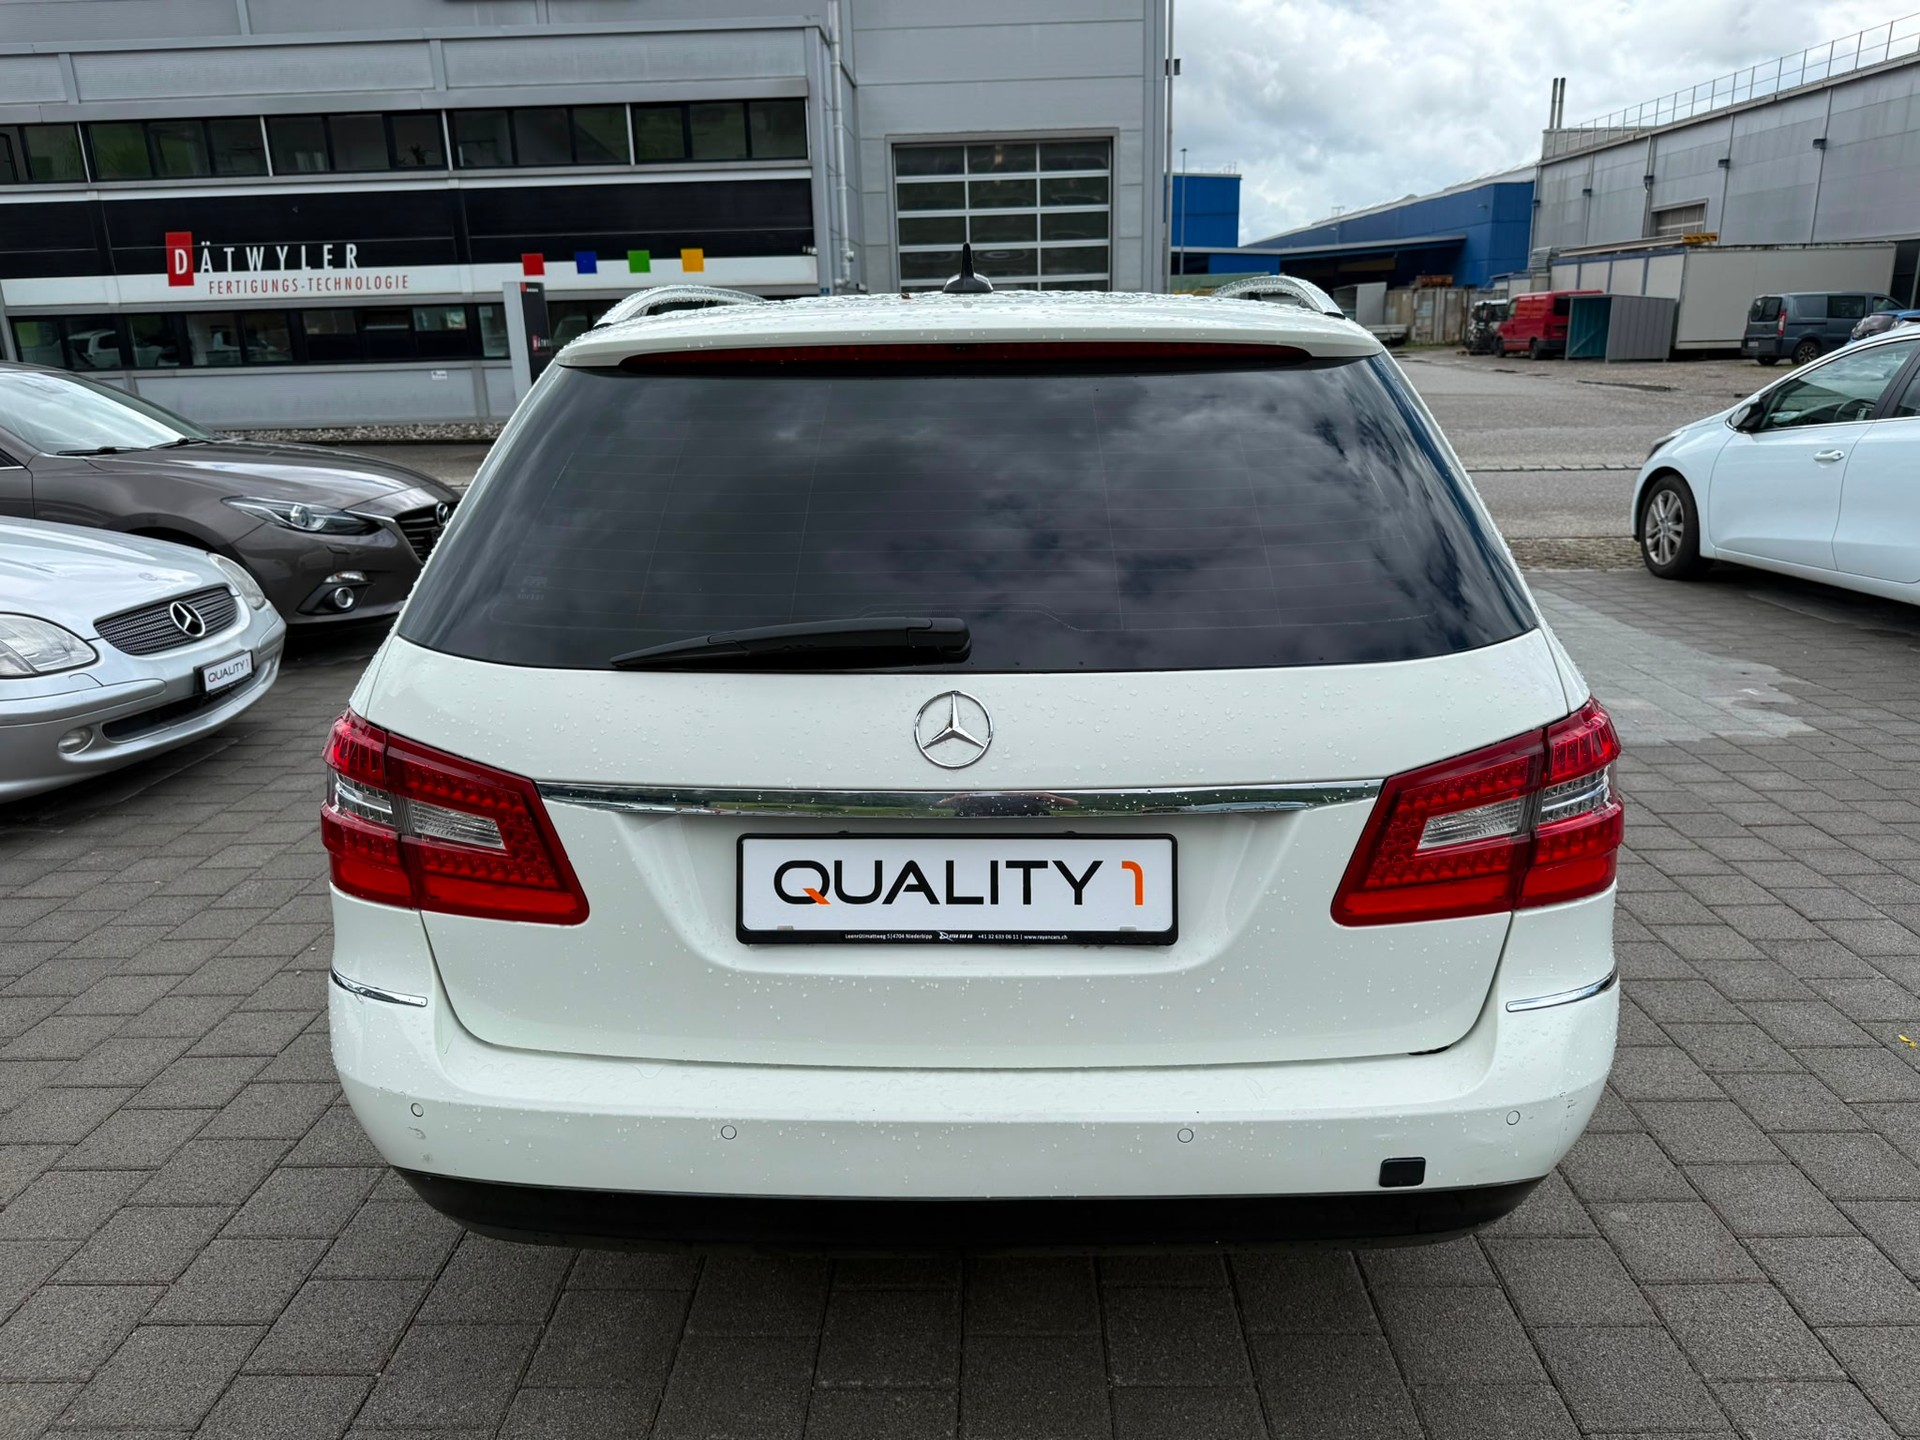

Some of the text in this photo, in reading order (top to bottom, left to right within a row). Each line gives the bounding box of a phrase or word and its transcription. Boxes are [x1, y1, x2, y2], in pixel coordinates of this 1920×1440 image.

[174, 240, 358, 275] DÄTWYLER
[208, 275, 409, 295] FERTIGUNGS-TECHNOLOGIE
[208, 660, 244, 682] QUALITY
[773, 859, 1144, 906] QUALITY 1
